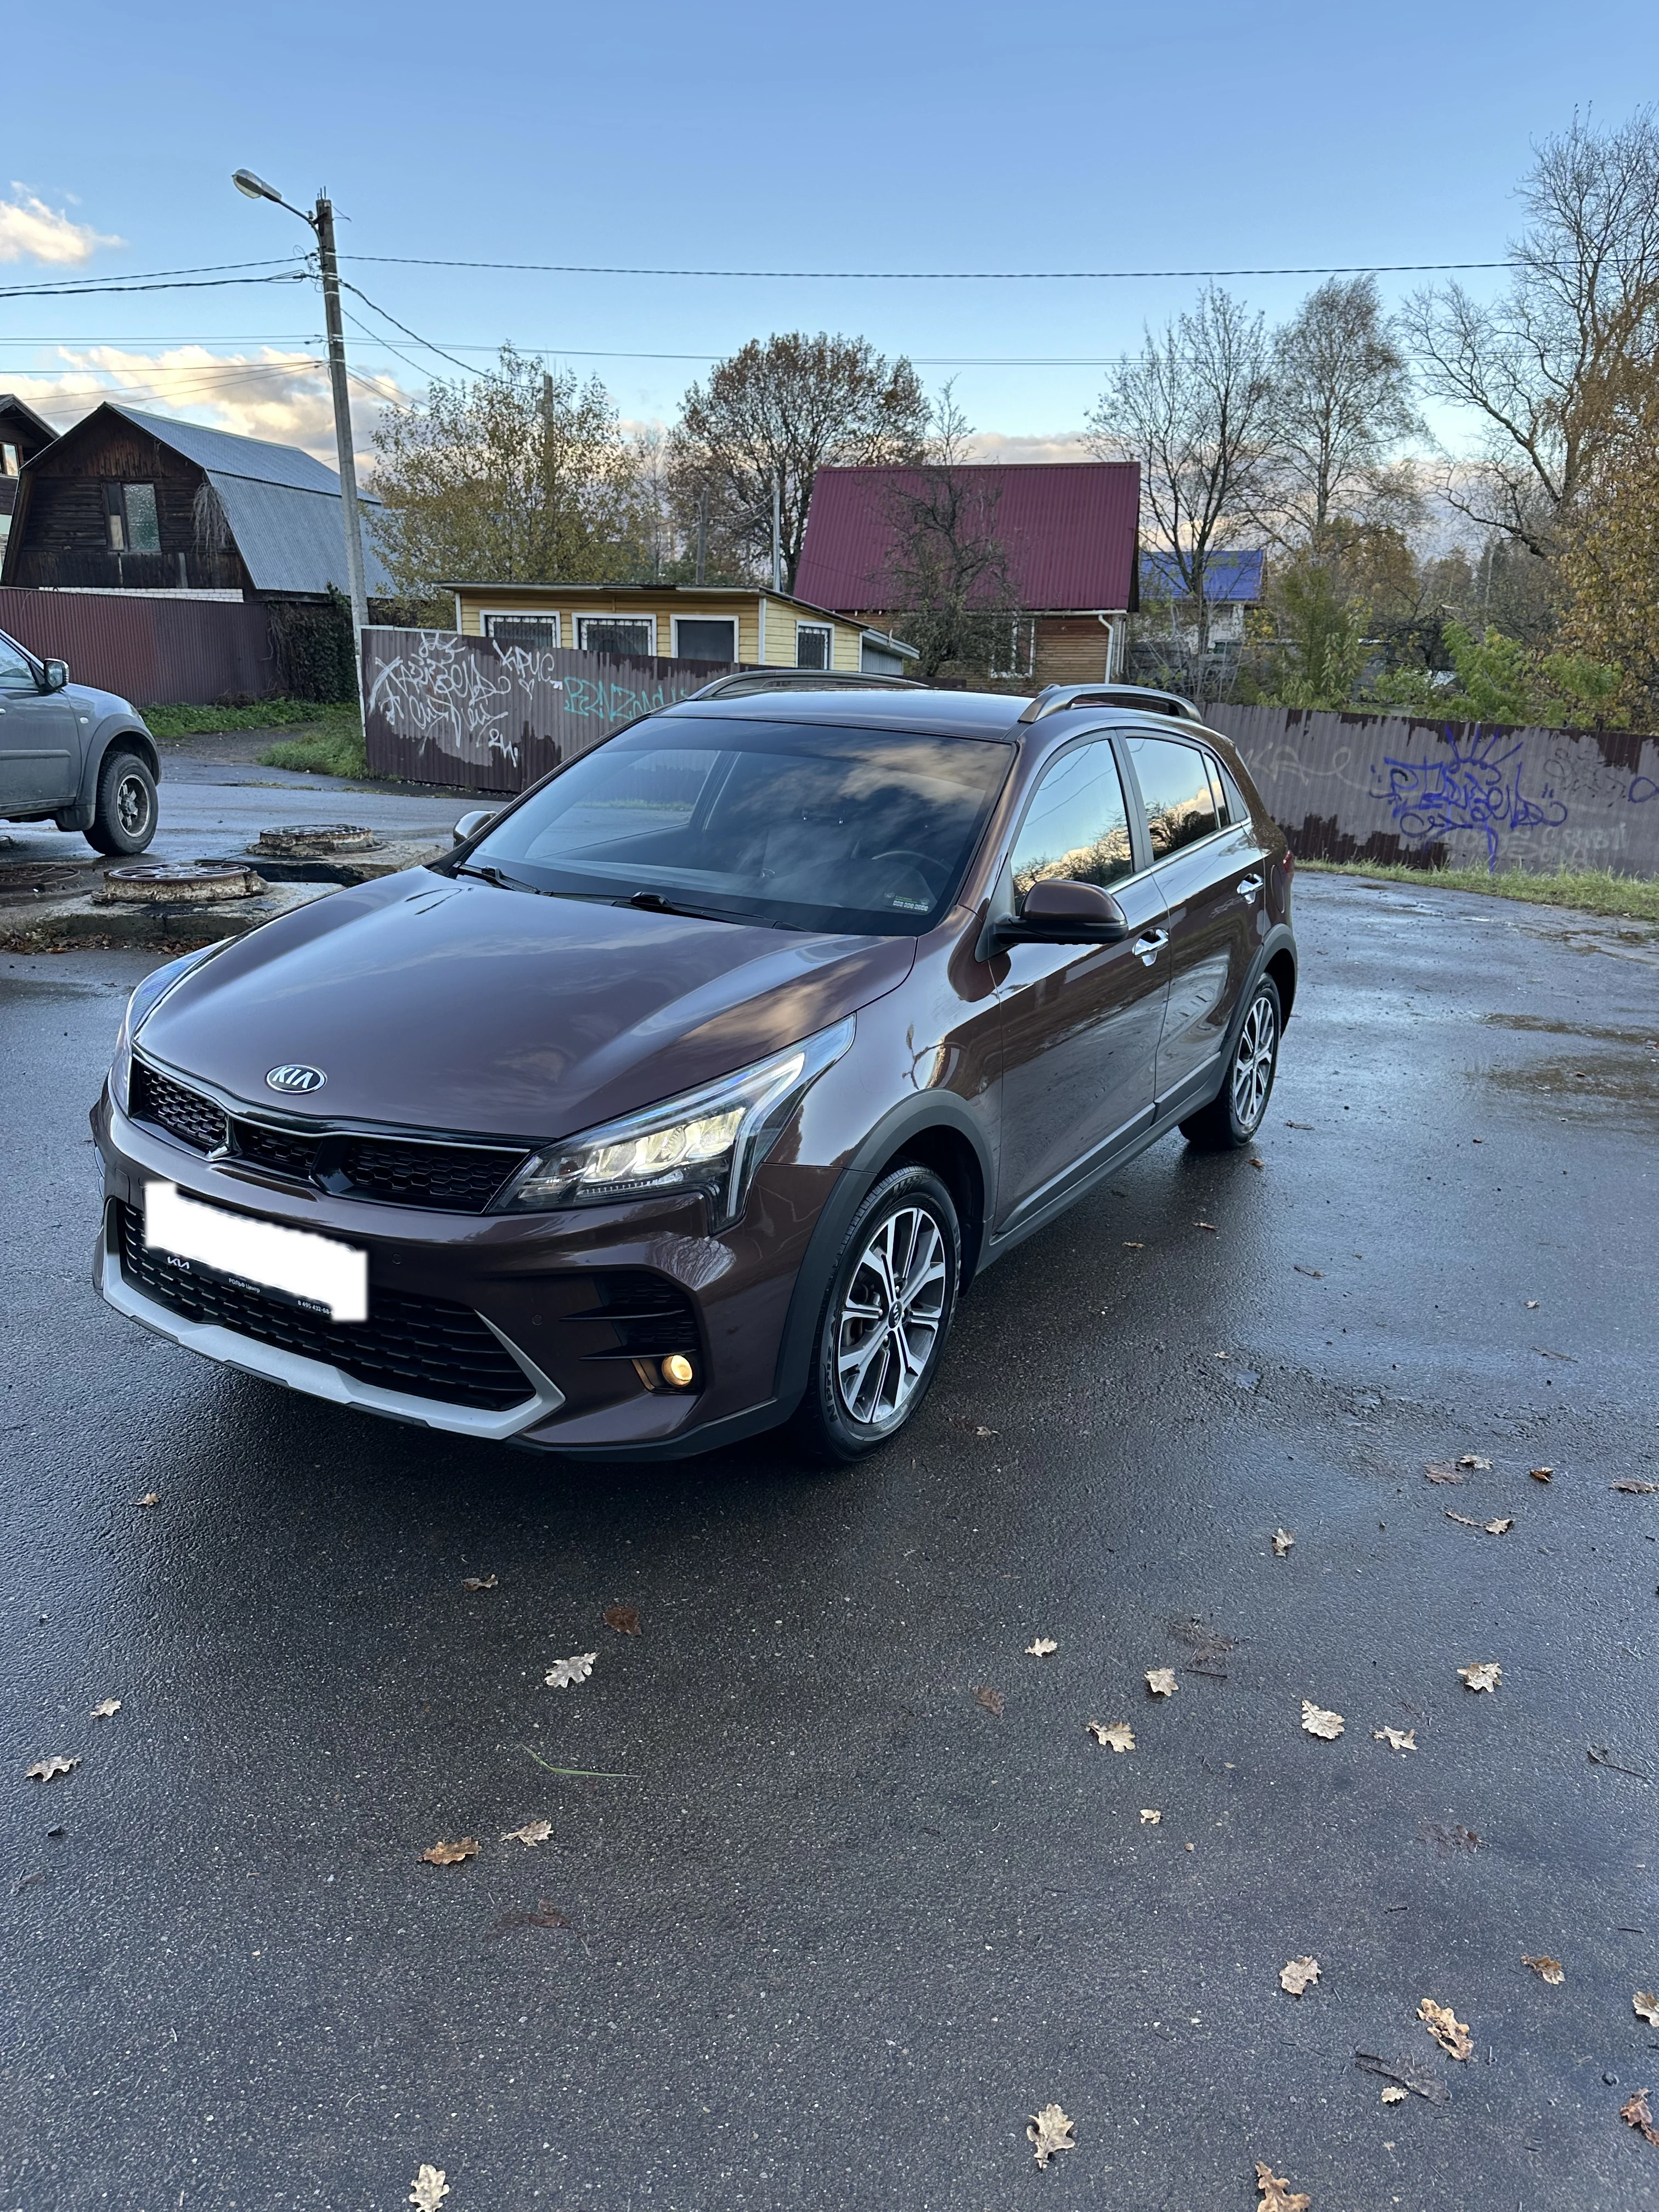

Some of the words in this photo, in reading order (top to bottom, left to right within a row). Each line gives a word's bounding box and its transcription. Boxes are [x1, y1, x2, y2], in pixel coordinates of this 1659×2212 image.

[272, 1066, 314, 1089] KIA
[167, 1256, 190, 1269] KIA
[228, 1277, 245, 1288] РОЛЬФ
